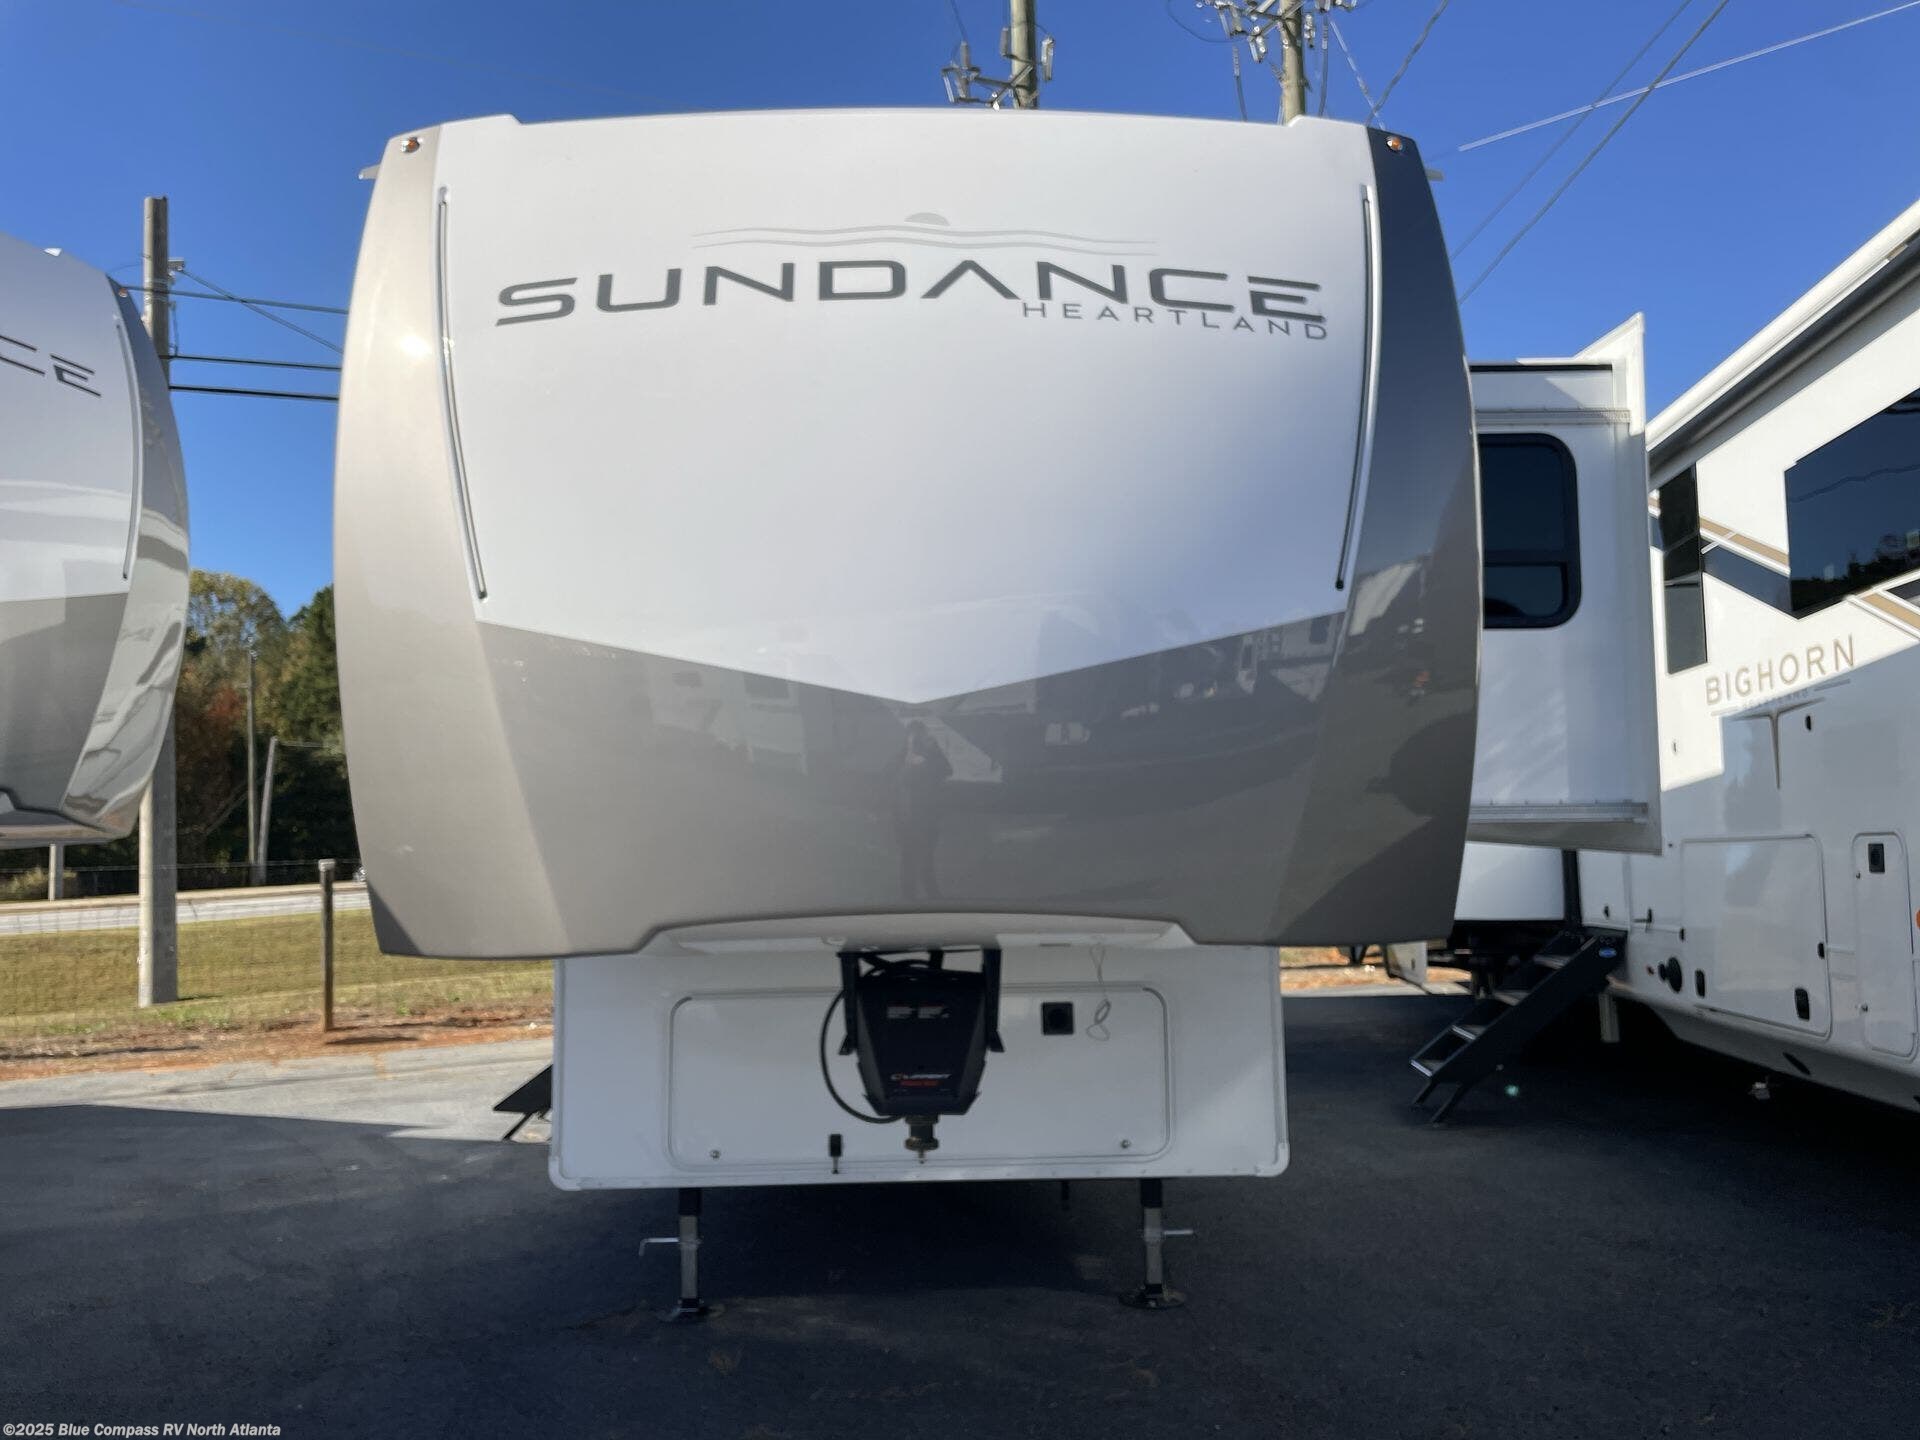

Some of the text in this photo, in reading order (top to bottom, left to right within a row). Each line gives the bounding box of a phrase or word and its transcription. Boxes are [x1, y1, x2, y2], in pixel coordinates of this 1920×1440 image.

[496, 259, 1327, 327] SUNDANCE
[1022, 302, 1327, 341] HEARTLAND
[1705, 634, 1857, 705] BIGHORN
